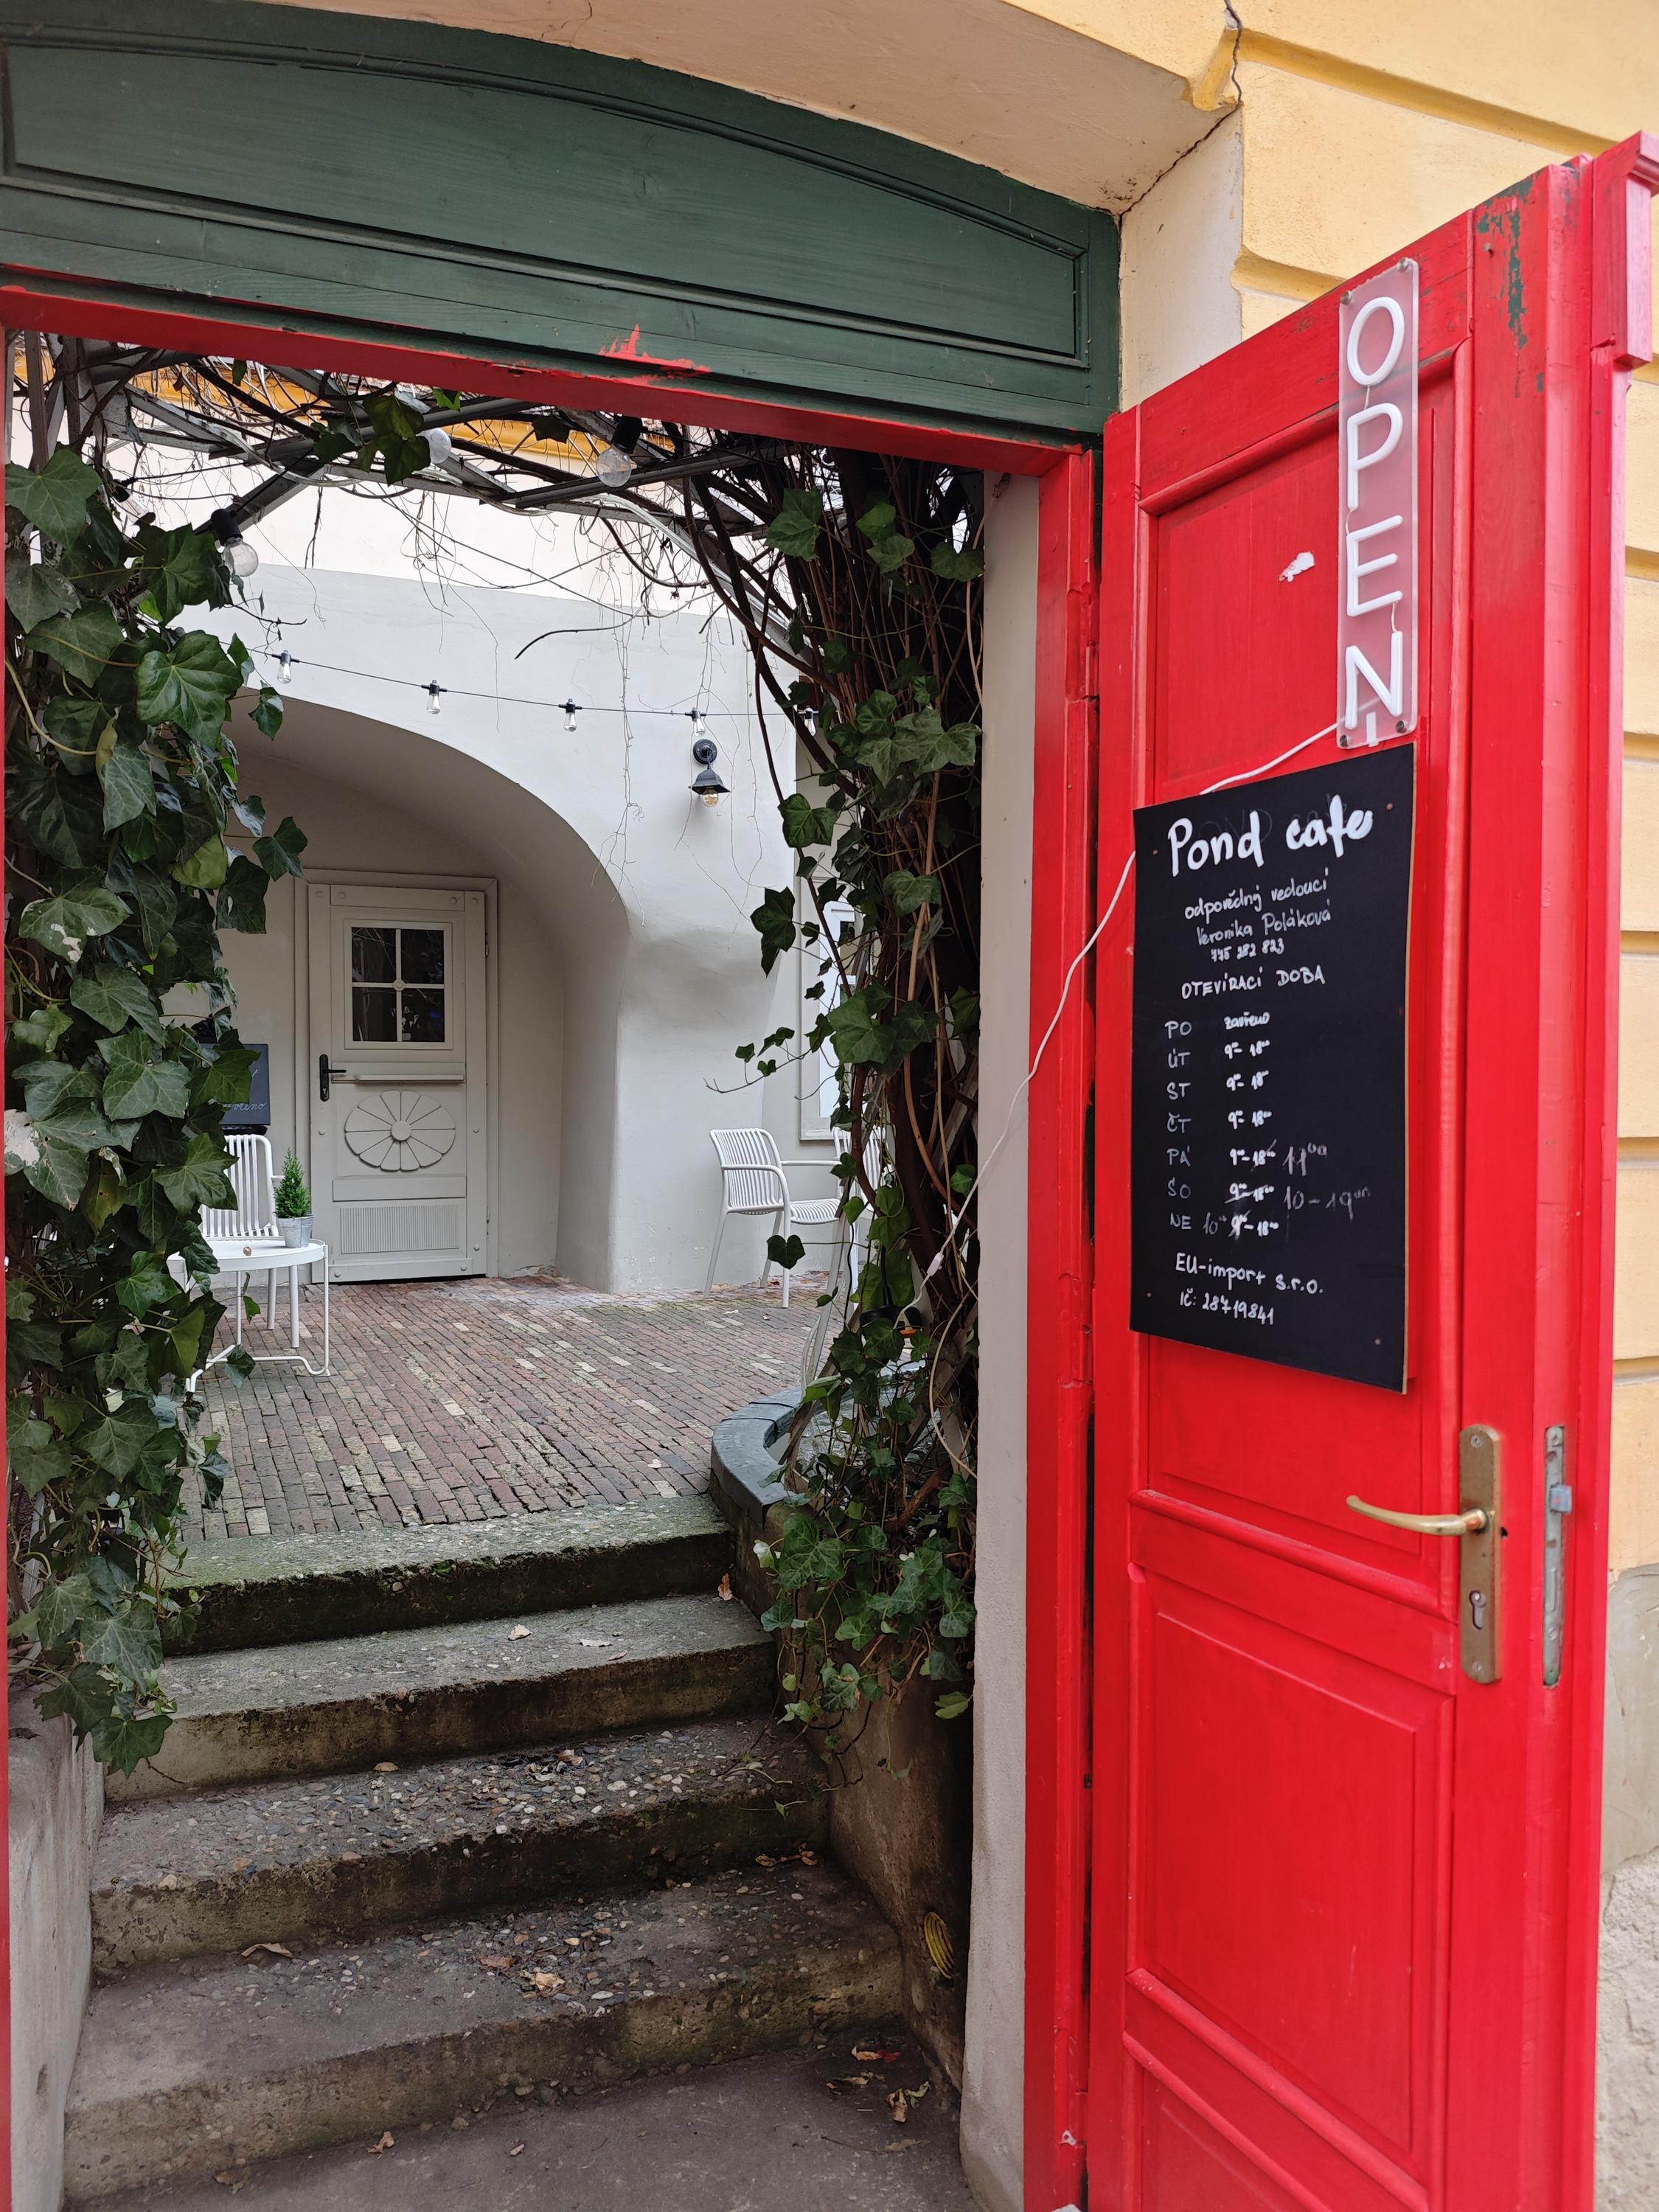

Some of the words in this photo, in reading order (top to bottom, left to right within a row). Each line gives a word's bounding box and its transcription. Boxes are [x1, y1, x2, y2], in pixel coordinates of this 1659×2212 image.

[1346, 296, 1405, 729] OPEN
[1168, 810, 1264, 877] Pond
[1286, 794, 1373, 858] cafe
[1185, 885, 1262, 925] odpovědný
[1271, 867, 1328, 902] vedoucí
[1197, 919, 1253, 945] Veronika
[1262, 899, 1331, 936] Poláková
[1262, 938, 1284, 954] 823
[1276, 964, 1325, 987] DOBA
[1165, 1020, 1192, 1039] PO
[1168, 1048, 1191, 1068] ÚT
[1166, 1082, 1191, 1100] ST
[1166, 1112, 1192, 1133] ČT
[1166, 1145, 1191, 1167] PÁ
[1167, 1177, 1191, 1199] SO
[1169, 1212, 1192, 1230] NE
[1180, 1287, 1197, 1307] IČ:
[1202, 1292, 1275, 1325] 28719841
